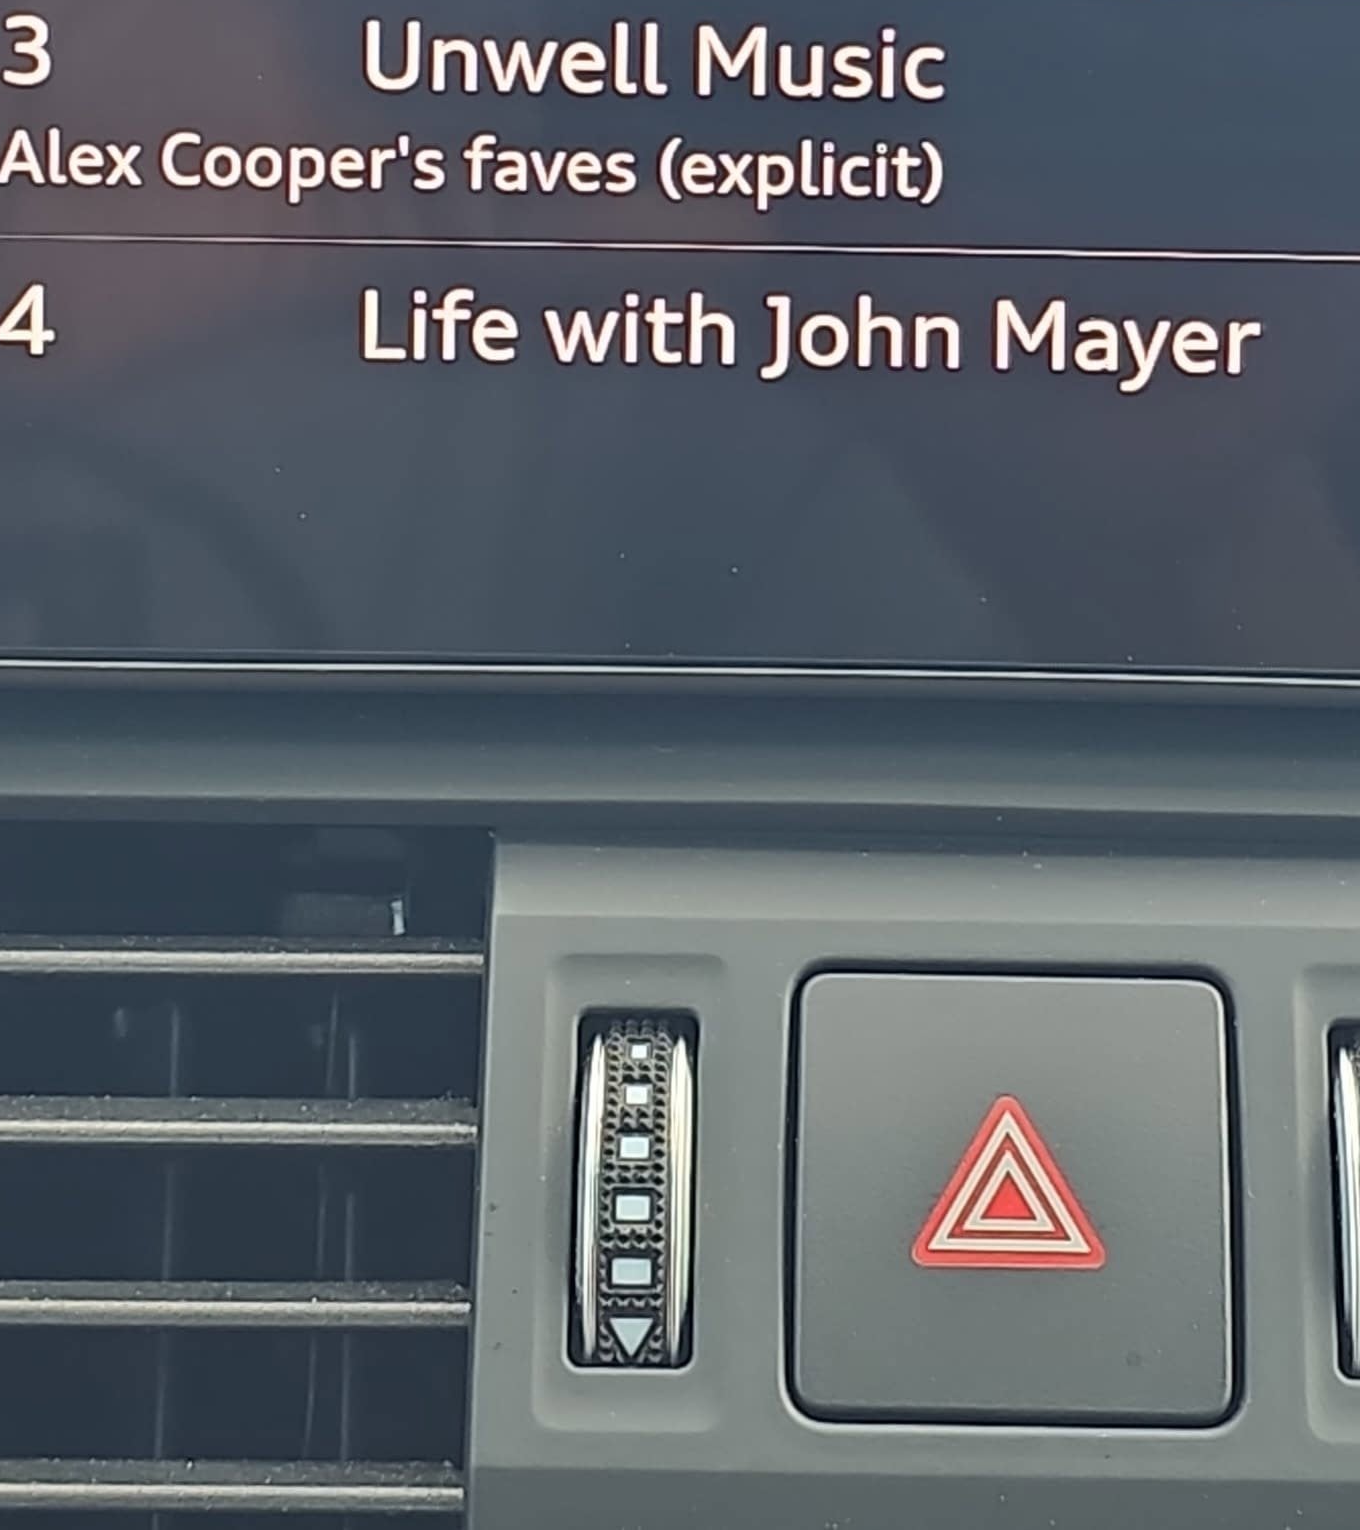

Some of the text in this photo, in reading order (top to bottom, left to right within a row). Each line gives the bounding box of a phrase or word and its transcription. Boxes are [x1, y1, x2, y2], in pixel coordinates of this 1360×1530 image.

[2, 14, 53, 87] 3
[363, 19, 946, 101] Unwell Music
[160, 132, 444, 204] Cooper's
[466, 134, 637, 193] faves
[659, 136, 945, 210] (explicit)
[362, 287, 1262, 393] Life with John Mayer
